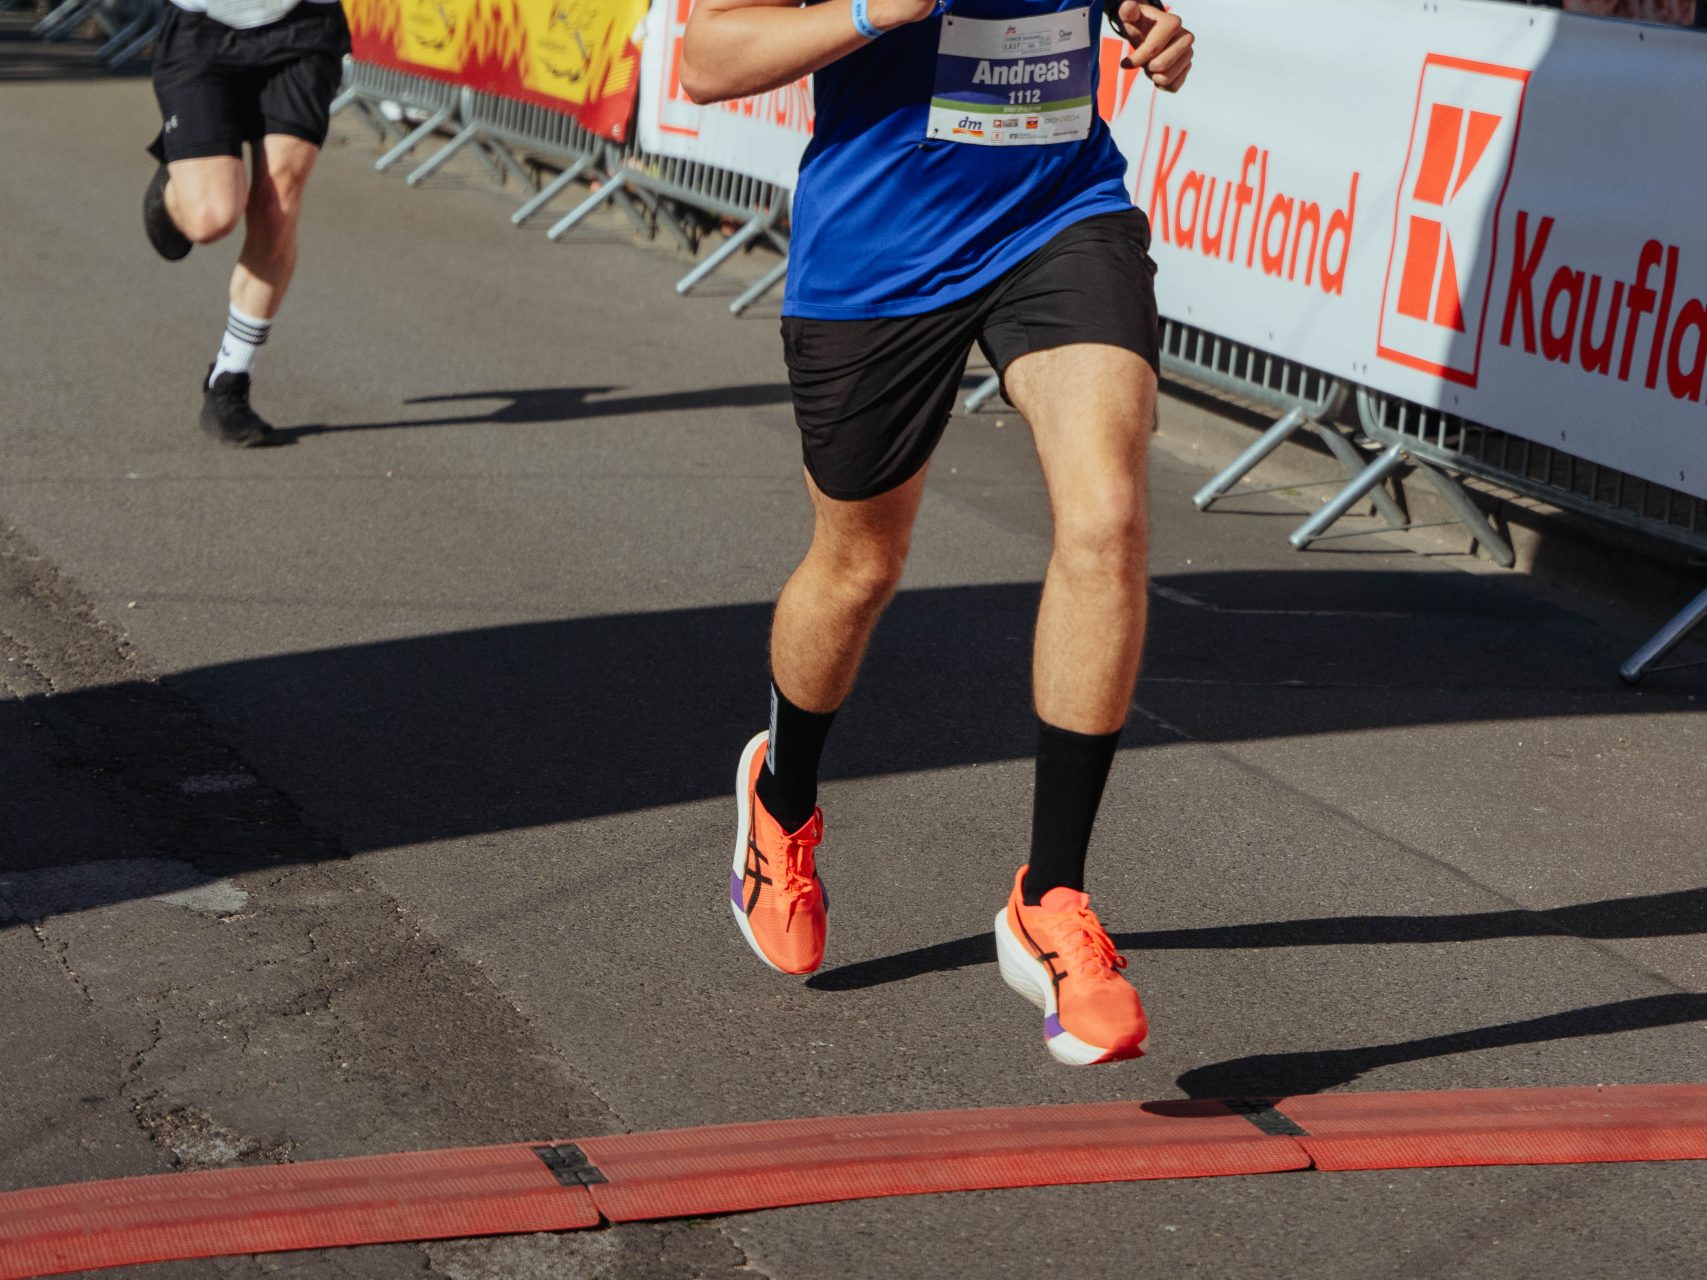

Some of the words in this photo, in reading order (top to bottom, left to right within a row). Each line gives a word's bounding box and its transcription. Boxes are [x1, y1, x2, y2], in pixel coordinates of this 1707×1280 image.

[972, 59, 1070, 85] Andreas
[1008, 89, 1041, 105] 1112
[958, 116, 982, 131] dm
[1149, 125, 1360, 296] Kaufland
[1500, 210, 1707, 406] Kaufla
